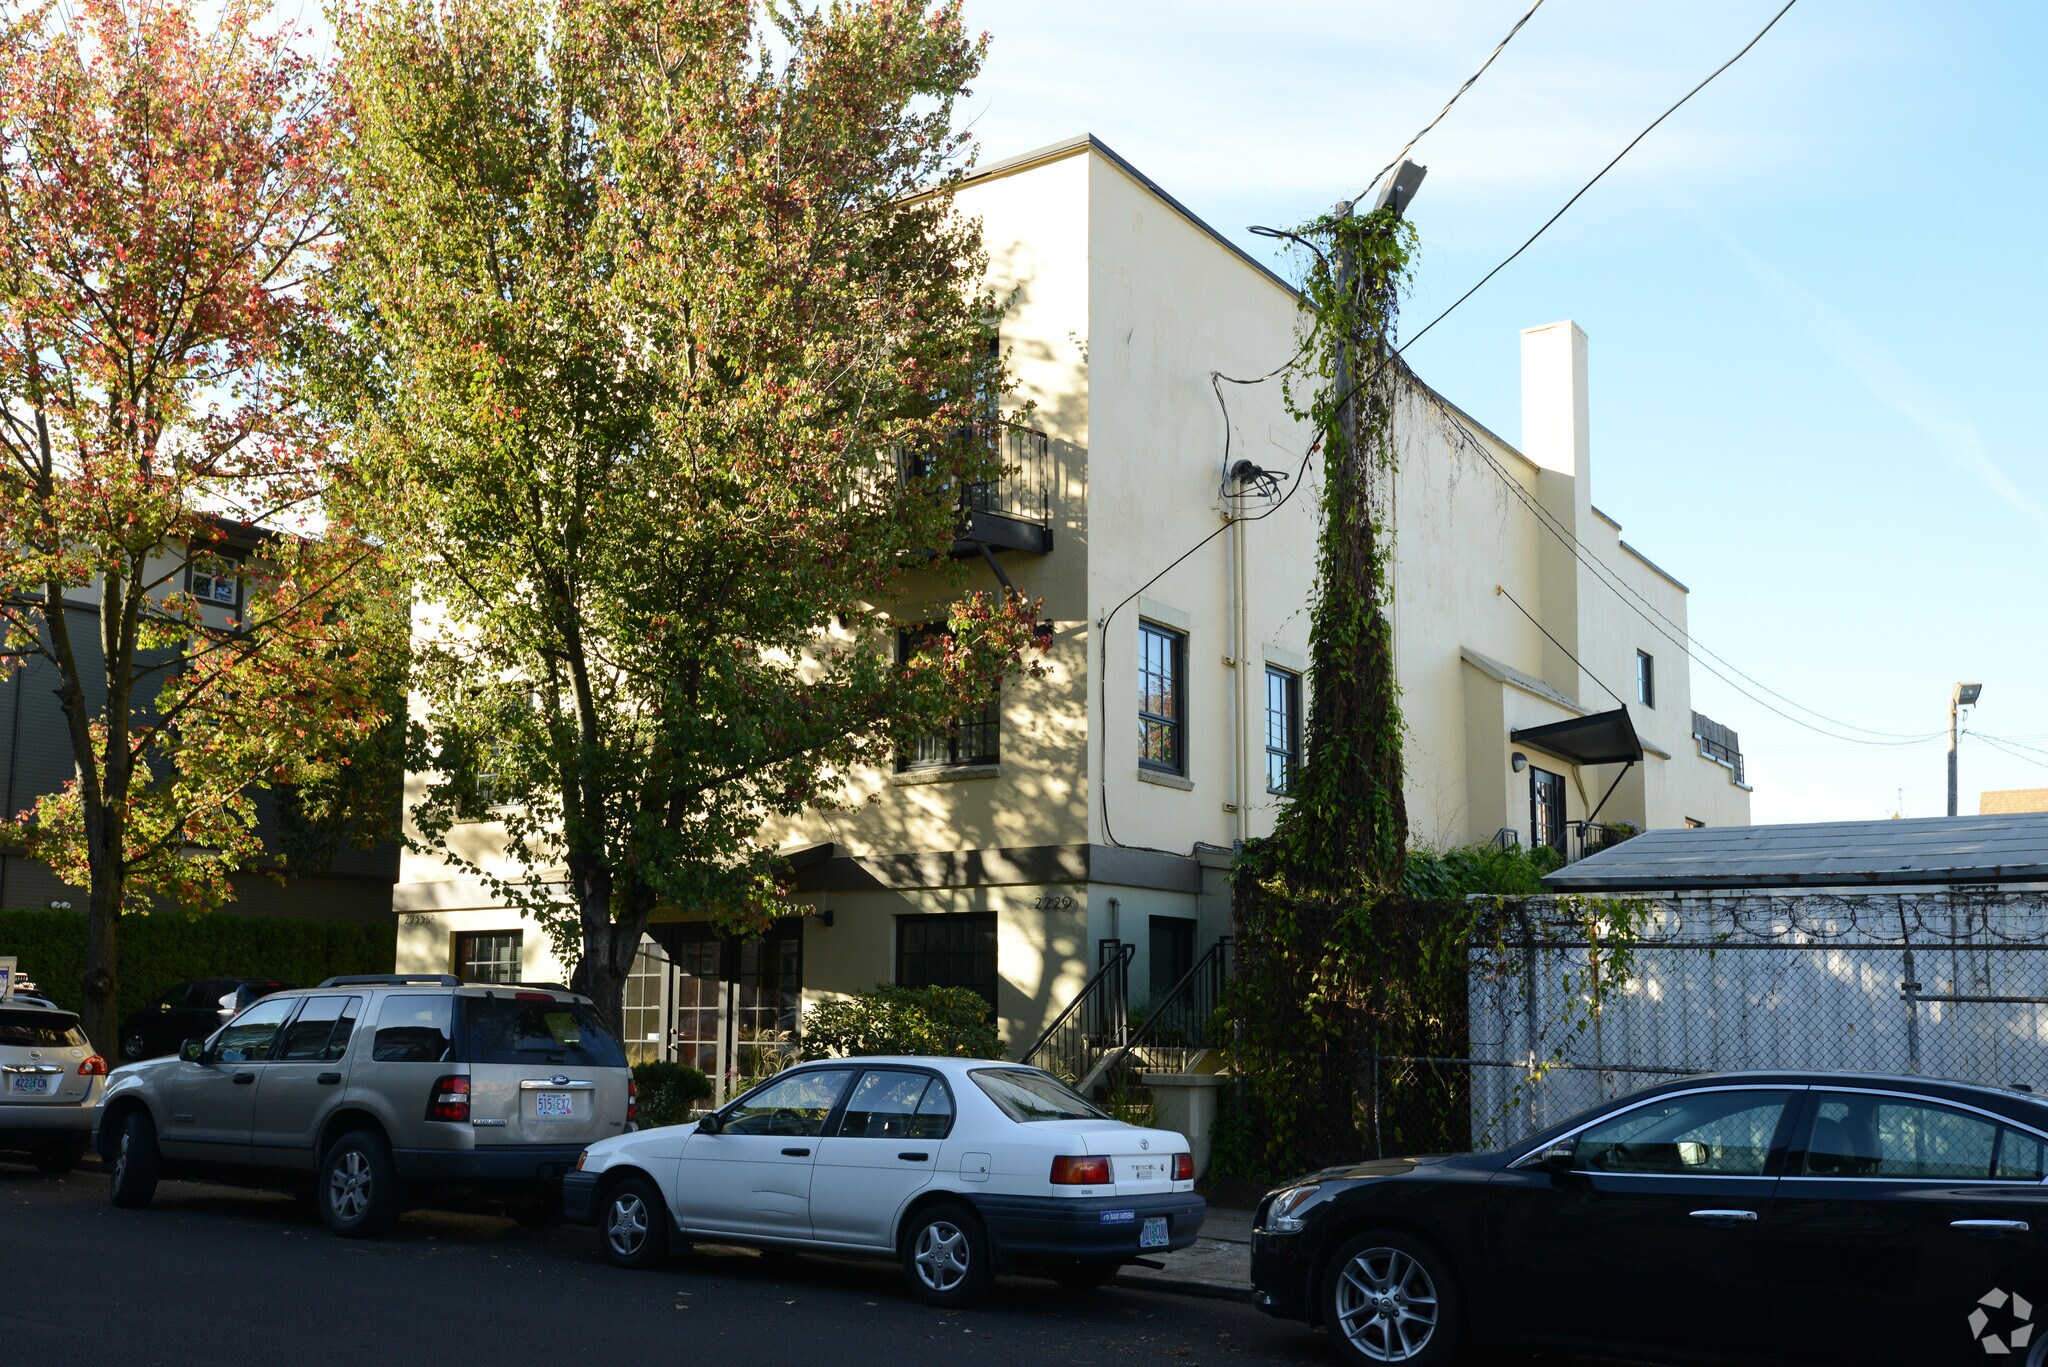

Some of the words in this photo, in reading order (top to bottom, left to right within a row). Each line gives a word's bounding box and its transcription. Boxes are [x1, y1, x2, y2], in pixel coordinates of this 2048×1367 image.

[1034, 896, 1072, 910] 2229
[538, 1098, 552, 1111] 515
[556, 1098, 571, 1111] EXZ
